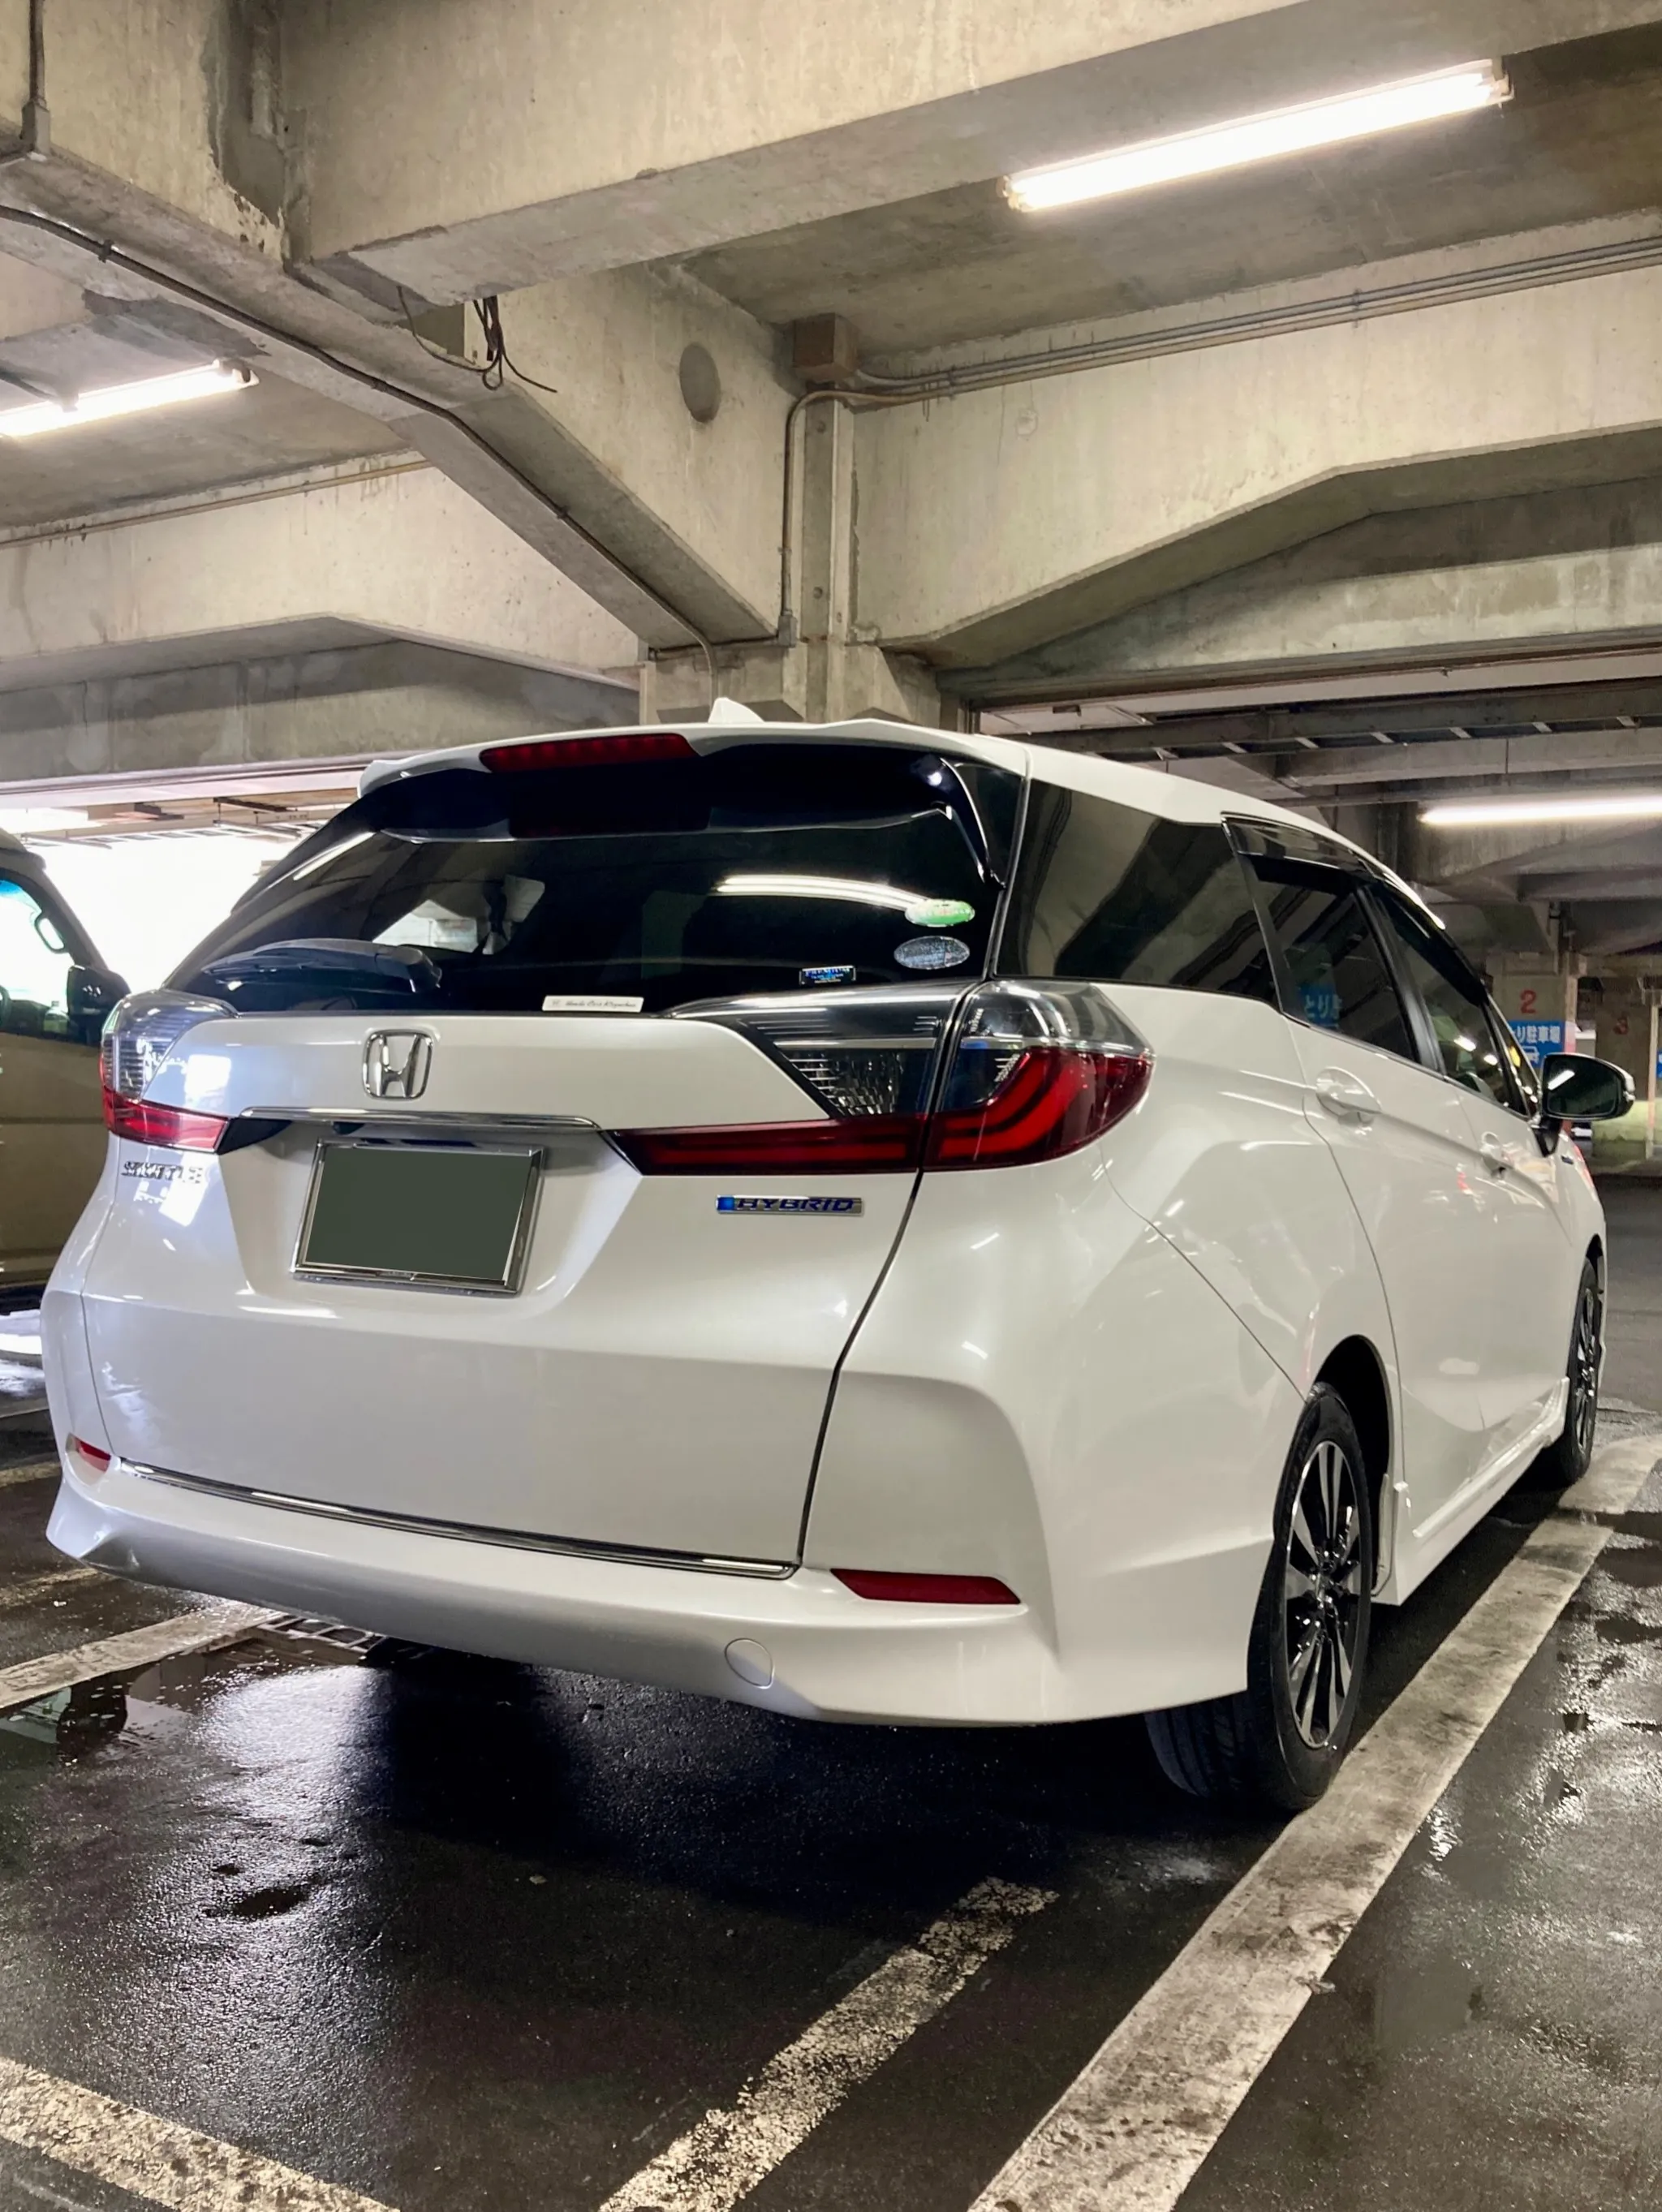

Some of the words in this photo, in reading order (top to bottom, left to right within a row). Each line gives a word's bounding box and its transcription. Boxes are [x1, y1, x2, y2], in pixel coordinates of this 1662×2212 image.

[1519, 989, 1538, 1013] 2
[1513, 1025, 1561, 1044] り駐車場
[121, 1161, 204, 1184] SHUTTE
[737, 1197, 855, 1211] HYBRID
